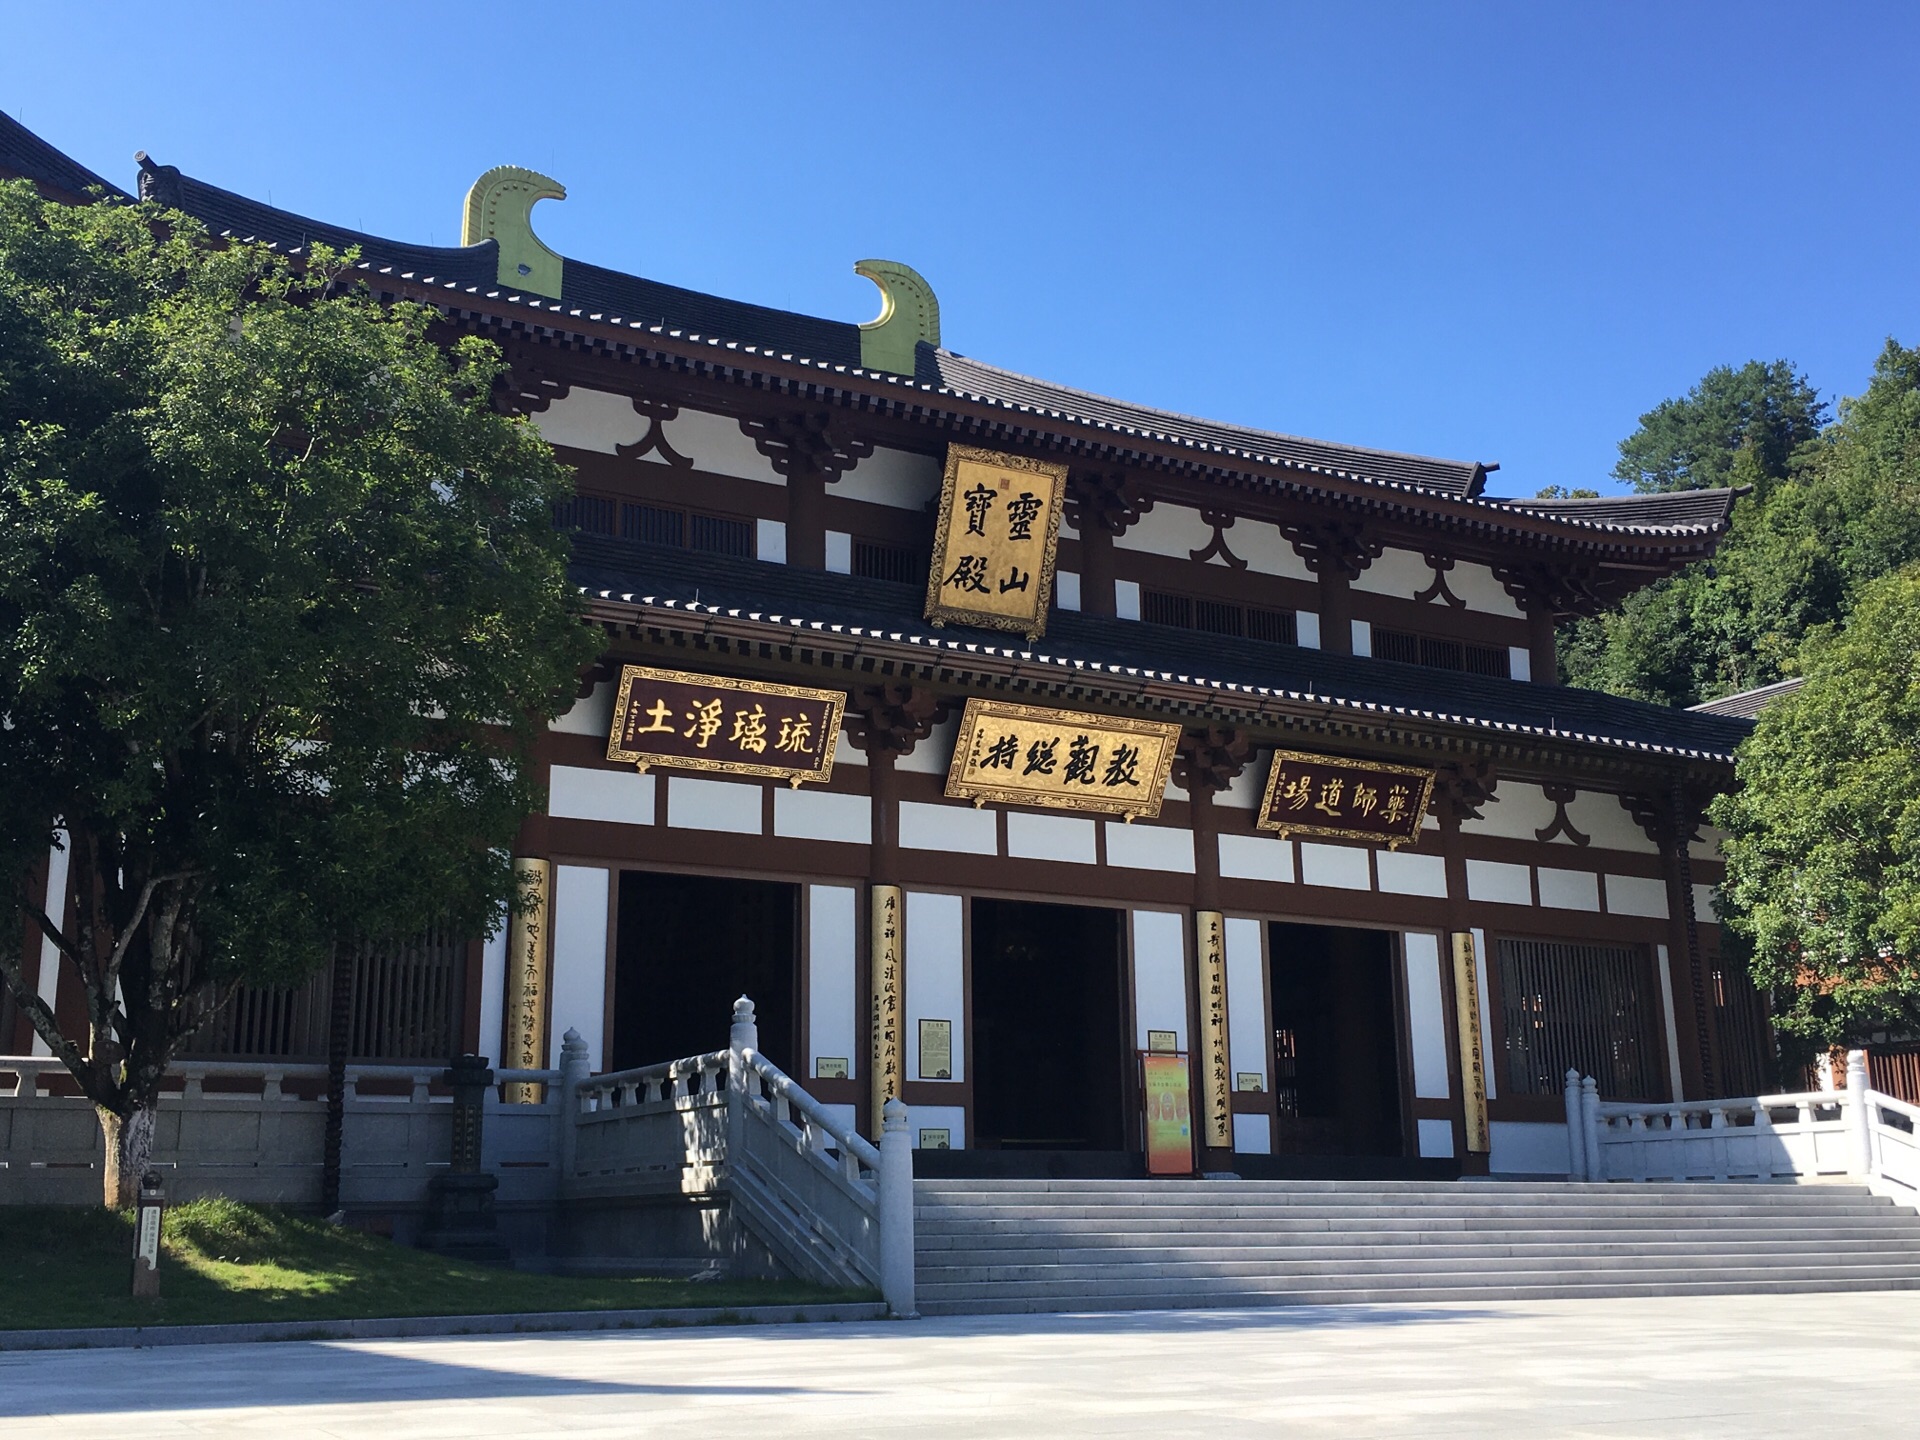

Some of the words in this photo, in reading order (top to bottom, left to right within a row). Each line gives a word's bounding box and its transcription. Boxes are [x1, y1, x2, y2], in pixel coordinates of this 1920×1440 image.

[943, 482, 998, 594] 寶殿
[999, 492, 1043, 595] 靈山
[638, 698, 813, 754] 琉璃淨土
[1283, 776, 1409, 825] 藥師道場
